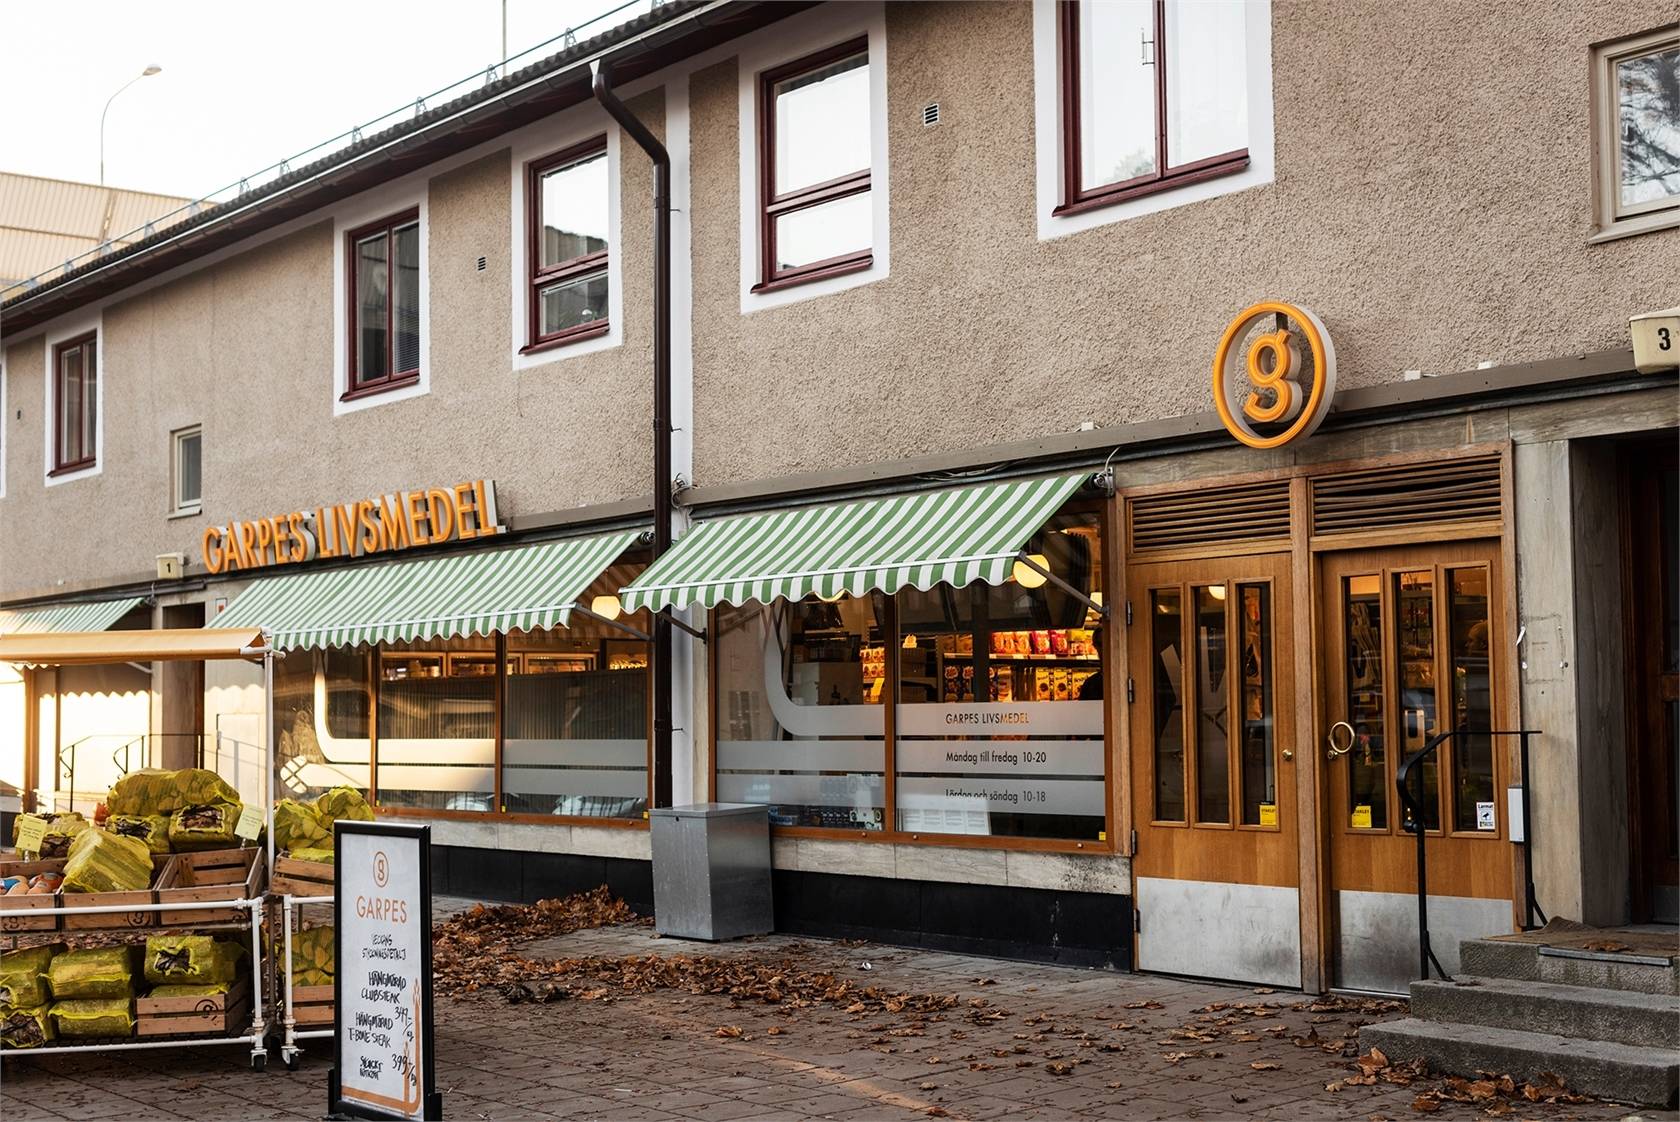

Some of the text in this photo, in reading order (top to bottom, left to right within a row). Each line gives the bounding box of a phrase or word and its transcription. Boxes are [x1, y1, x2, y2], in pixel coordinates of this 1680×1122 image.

[1657, 327, 1672, 351] 3
[202, 479, 499, 574] GARPES LIVSMEDEL
[945, 713, 1029, 724] GARPES LIVSMEDEL
[946, 750, 1047, 765] Måndag till fredag 10-20
[989, 789, 1018, 804] söndag
[1023, 791, 1046, 802] 10-18
[356, 895, 407, 924] GARPES
